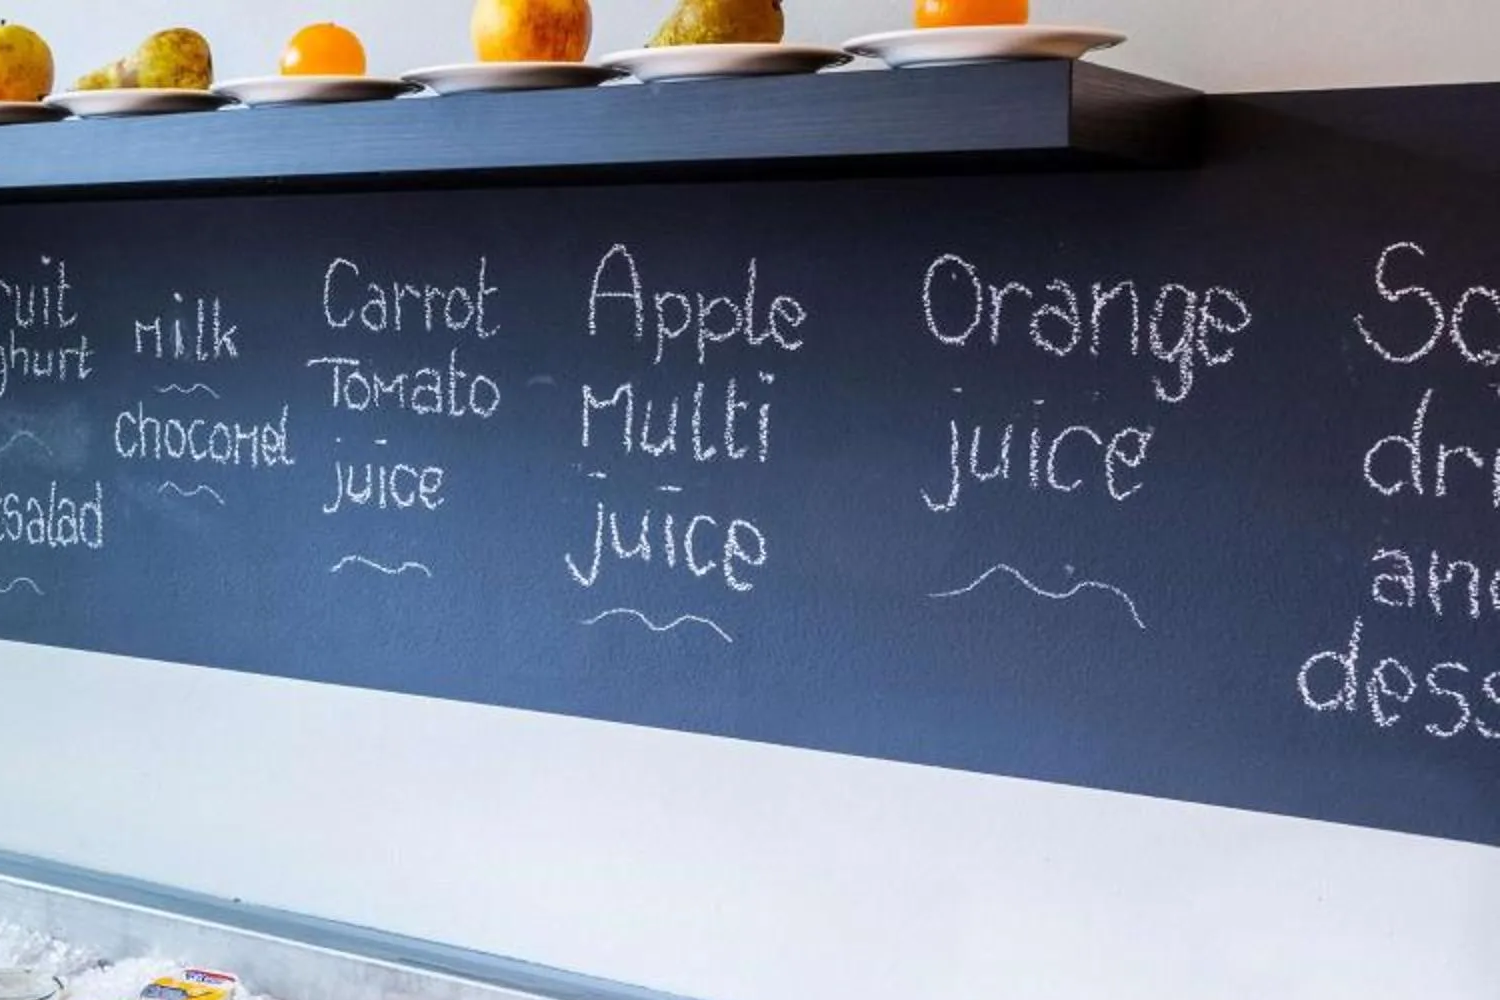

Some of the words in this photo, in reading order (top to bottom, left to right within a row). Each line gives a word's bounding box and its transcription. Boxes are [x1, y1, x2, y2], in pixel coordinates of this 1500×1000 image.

[324, 255, 500, 339] Carrot
[589, 243, 807, 365] Apple
[922, 253, 1252, 402] Orange
[307, 348, 501, 419] Tomato
[582, 369, 775, 463] Multi
[323, 436, 446, 515] juice
[920, 385, 1156, 512] juice
[564, 471, 768, 592] juice
